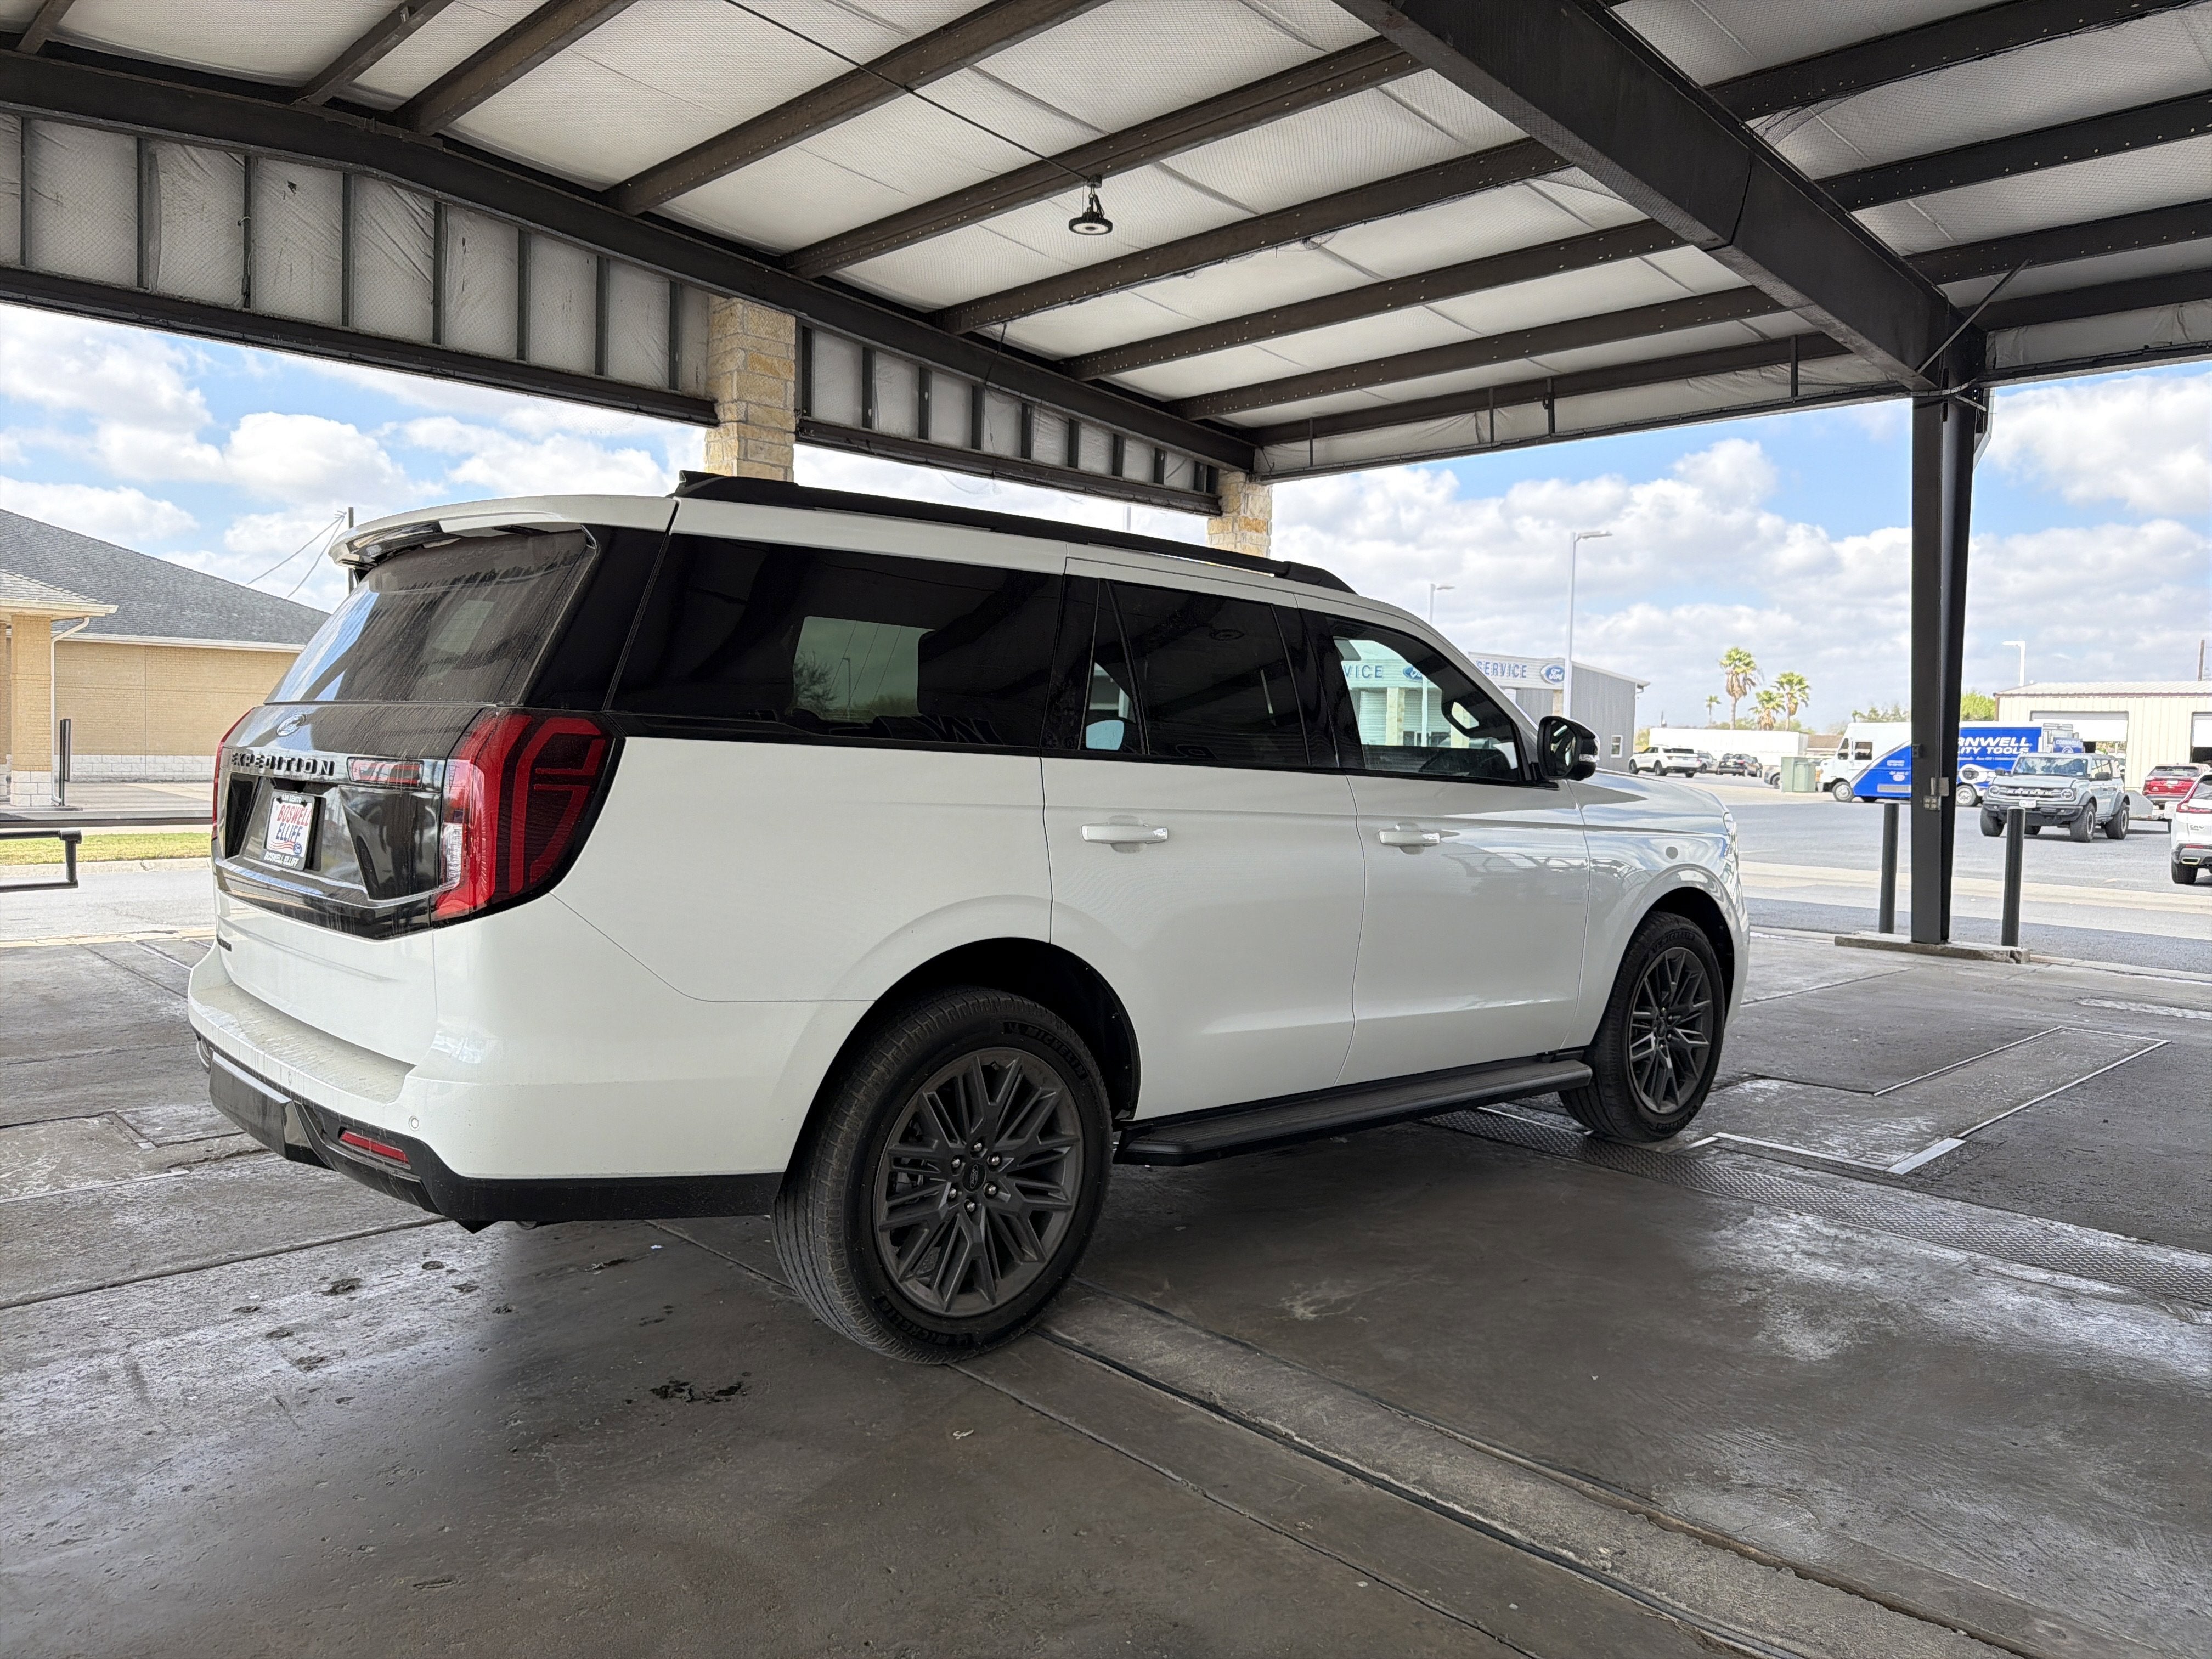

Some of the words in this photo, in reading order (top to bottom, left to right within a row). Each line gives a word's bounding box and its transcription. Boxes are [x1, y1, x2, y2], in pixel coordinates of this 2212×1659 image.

[1476, 661, 1527, 678] SERVICE
[232, 752, 335, 776] EXPEDITION
[277, 804, 313, 826] BOSWELL
[275, 822, 303, 843] ELLIFF
[264, 851, 284, 864] BOSWELL
[283, 855, 300, 867] ELLIFF
[1025, 1026, 1088, 1080] MICHELIN
